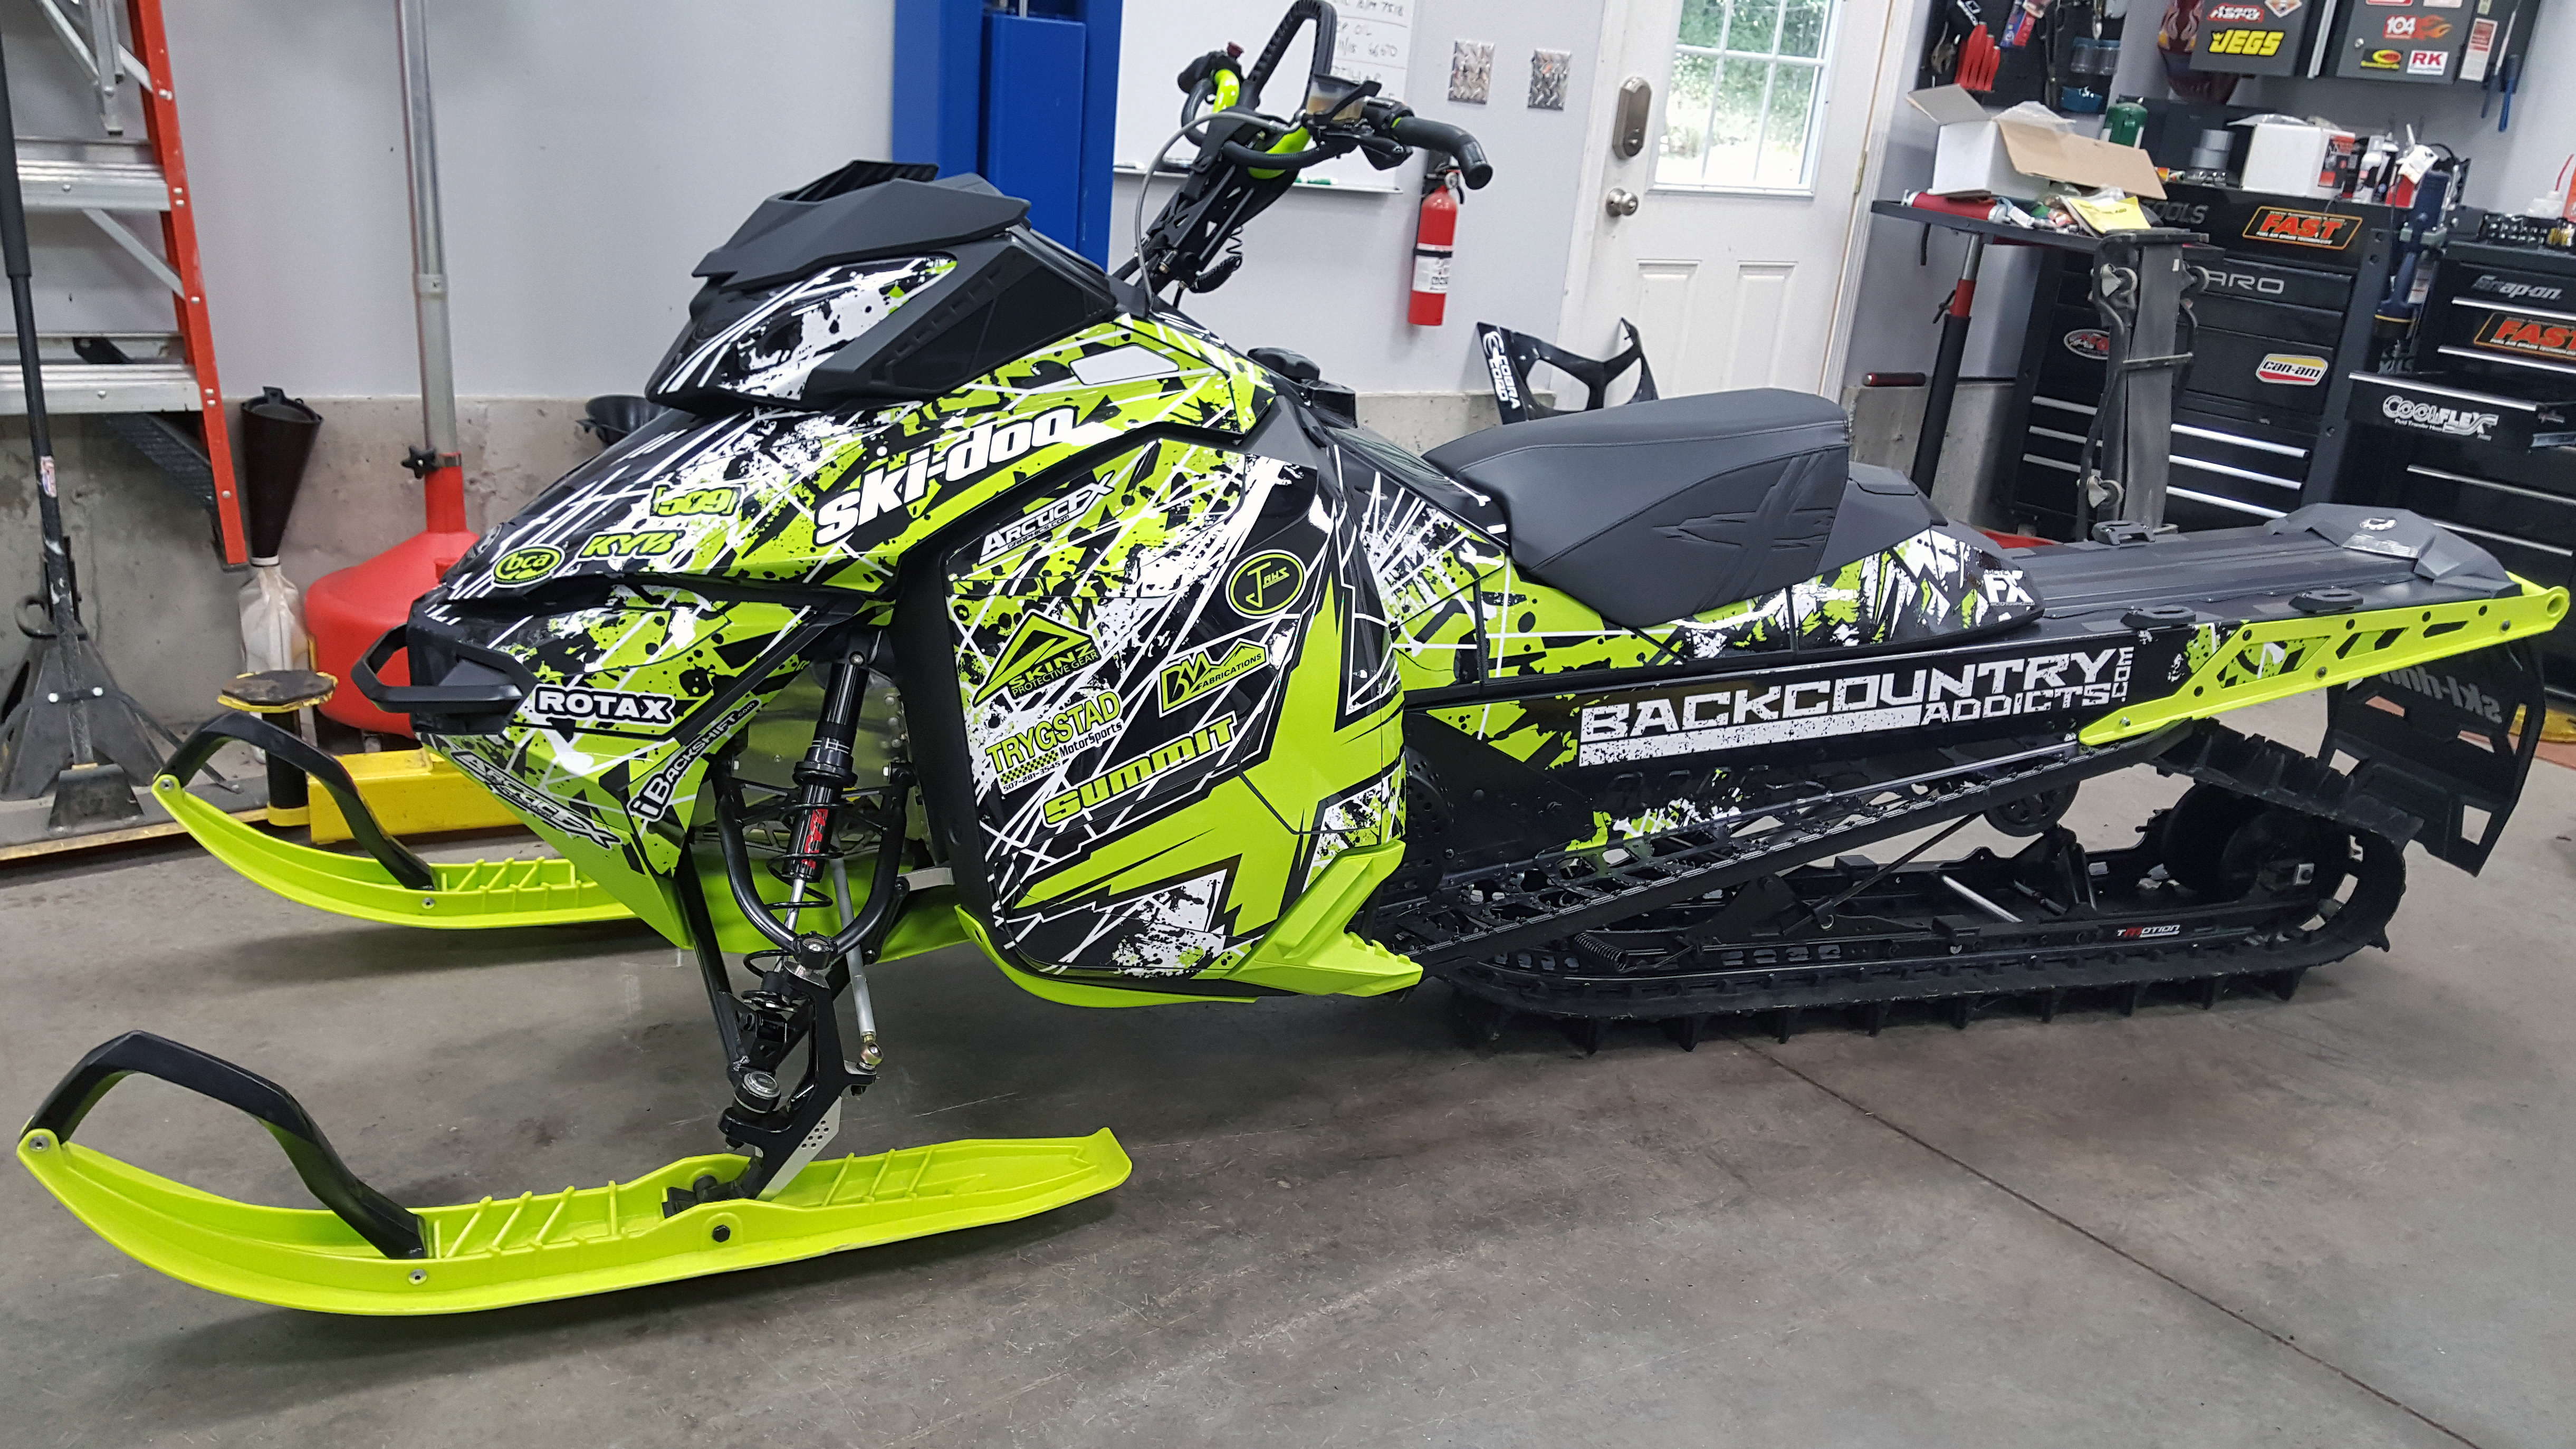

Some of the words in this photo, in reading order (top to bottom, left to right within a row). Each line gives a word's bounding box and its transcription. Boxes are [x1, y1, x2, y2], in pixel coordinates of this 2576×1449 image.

[2386, 16, 2416, 35] 104
[2209, 29, 2285, 56] JEGS
[2412, 52, 2443, 65] RK
[2259, 214, 2343, 239] FAST
[2207, 270, 2285, 294] ARO
[2263, 361, 2321, 378] can-am
[815, 407, 1076, 544] ski-doo
[657, 488, 734, 515] 509
[582, 532, 677, 556] KYB
[505, 552, 551, 571] bca
[1984, 570, 2035, 602] FX
[1008, 642, 1096, 690] SKINZ
[1011, 664, 1070, 697] PROTECTIVE
[1071, 652, 1099, 668] GEAR
[1194, 653, 1262, 692] FABRICATIONS
[539, 690, 668, 720] ROTAX
[1580, 649, 2117, 743] BACKCOUNTRY
[1920, 683, 2112, 726] ADDICTS
[985, 692, 1121, 773] TRYGSTAD
[1059, 722, 1123, 757] MotorSports
[1003, 761, 1061, 792] 507-281-3545
